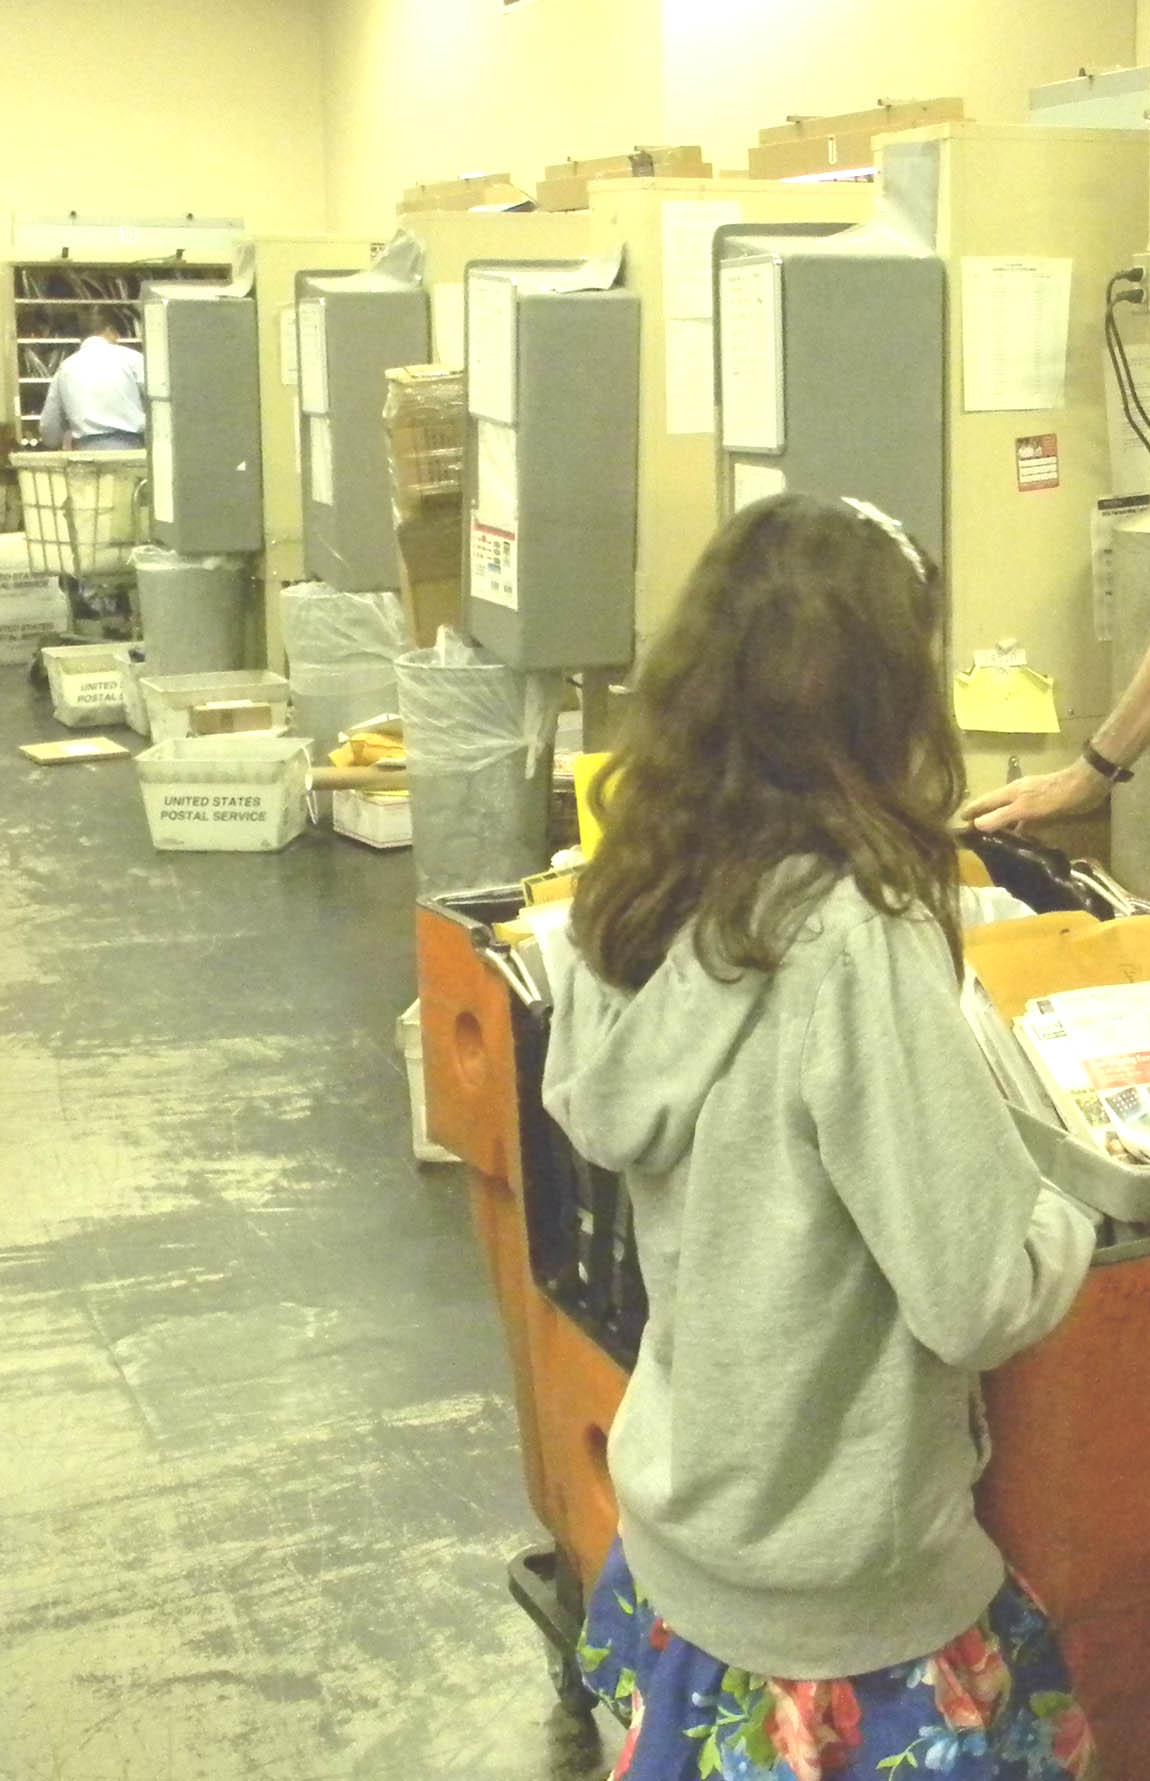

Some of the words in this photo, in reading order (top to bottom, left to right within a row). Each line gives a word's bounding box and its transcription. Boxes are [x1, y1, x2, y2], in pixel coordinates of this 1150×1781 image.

[80, 681, 118, 691] UNITED
[77, 692, 117, 702] POSTAL
[164, 796, 210, 807] UNITED
[212, 796, 262, 807] STATES
[160, 810, 209, 821] POSTAL
[212, 810, 266, 821] SERVICE
